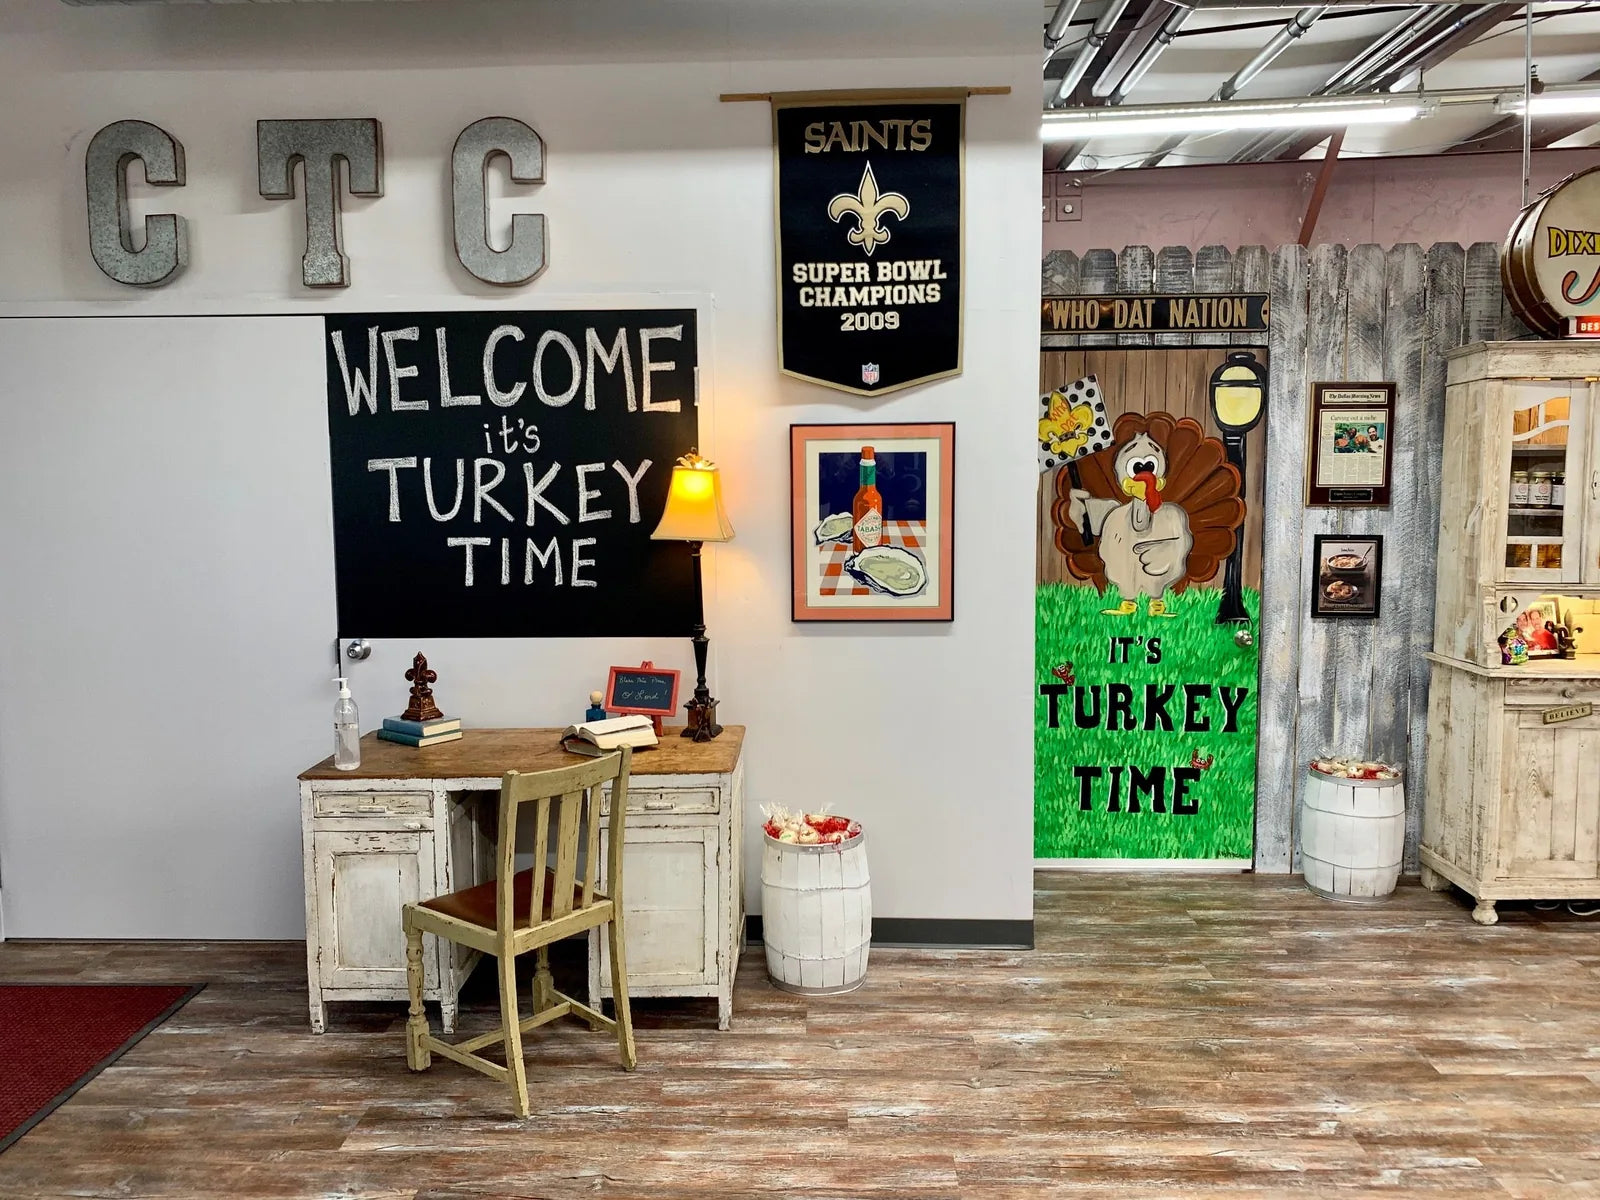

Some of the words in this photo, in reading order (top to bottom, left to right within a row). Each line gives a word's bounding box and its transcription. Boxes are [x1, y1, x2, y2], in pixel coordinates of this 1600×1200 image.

[804, 119, 933, 153] SAINTS
[792, 262, 871, 283] SUPER
[876, 259, 947, 282] BOWL
[799, 283, 941, 307] CHAMPIONS
[840, 311, 900, 331] 2009
[1051, 299, 1099, 330] WHO
[1113, 299, 1156, 329] DAT
[1169, 298, 1248, 328] NATION
[331, 324, 684, 416] WELCOME
[863, 371, 878, 381] NFL
[483, 415, 541, 454] it's
[367, 457, 653, 526] TURKEY
[447, 536, 598, 587] TIME
[1108, 636, 1162, 665] IT'S
[1039, 682, 1249, 733] TURKEY
[1548, 706, 1587, 720] BELIEVE
[1073, 765, 1202, 816] TIME
